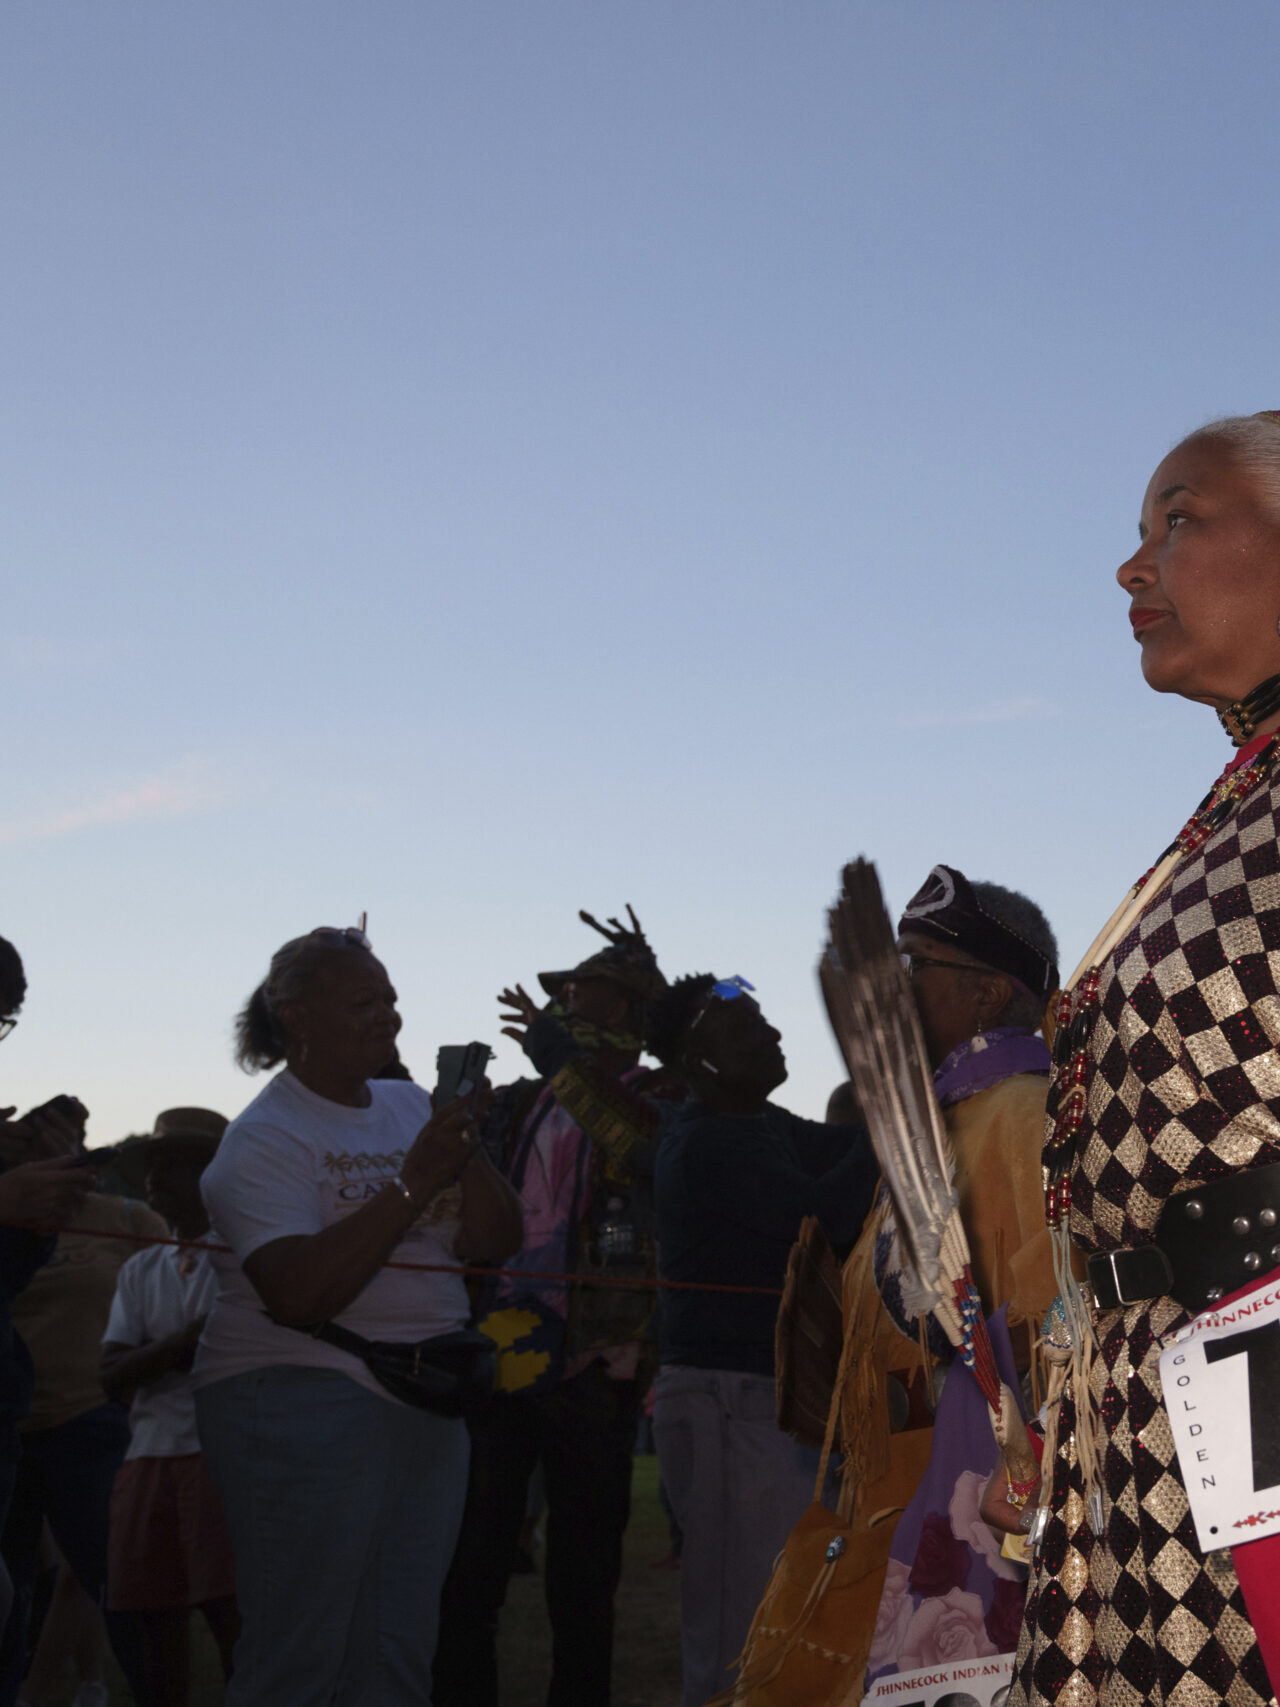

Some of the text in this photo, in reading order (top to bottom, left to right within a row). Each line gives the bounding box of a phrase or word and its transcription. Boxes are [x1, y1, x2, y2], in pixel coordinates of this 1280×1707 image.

[1173, 1354, 1217, 1490] GOLDEN
[876, 1672, 949, 1697] SHINNECOCK
[953, 1663, 1000, 1681] INDIAN
